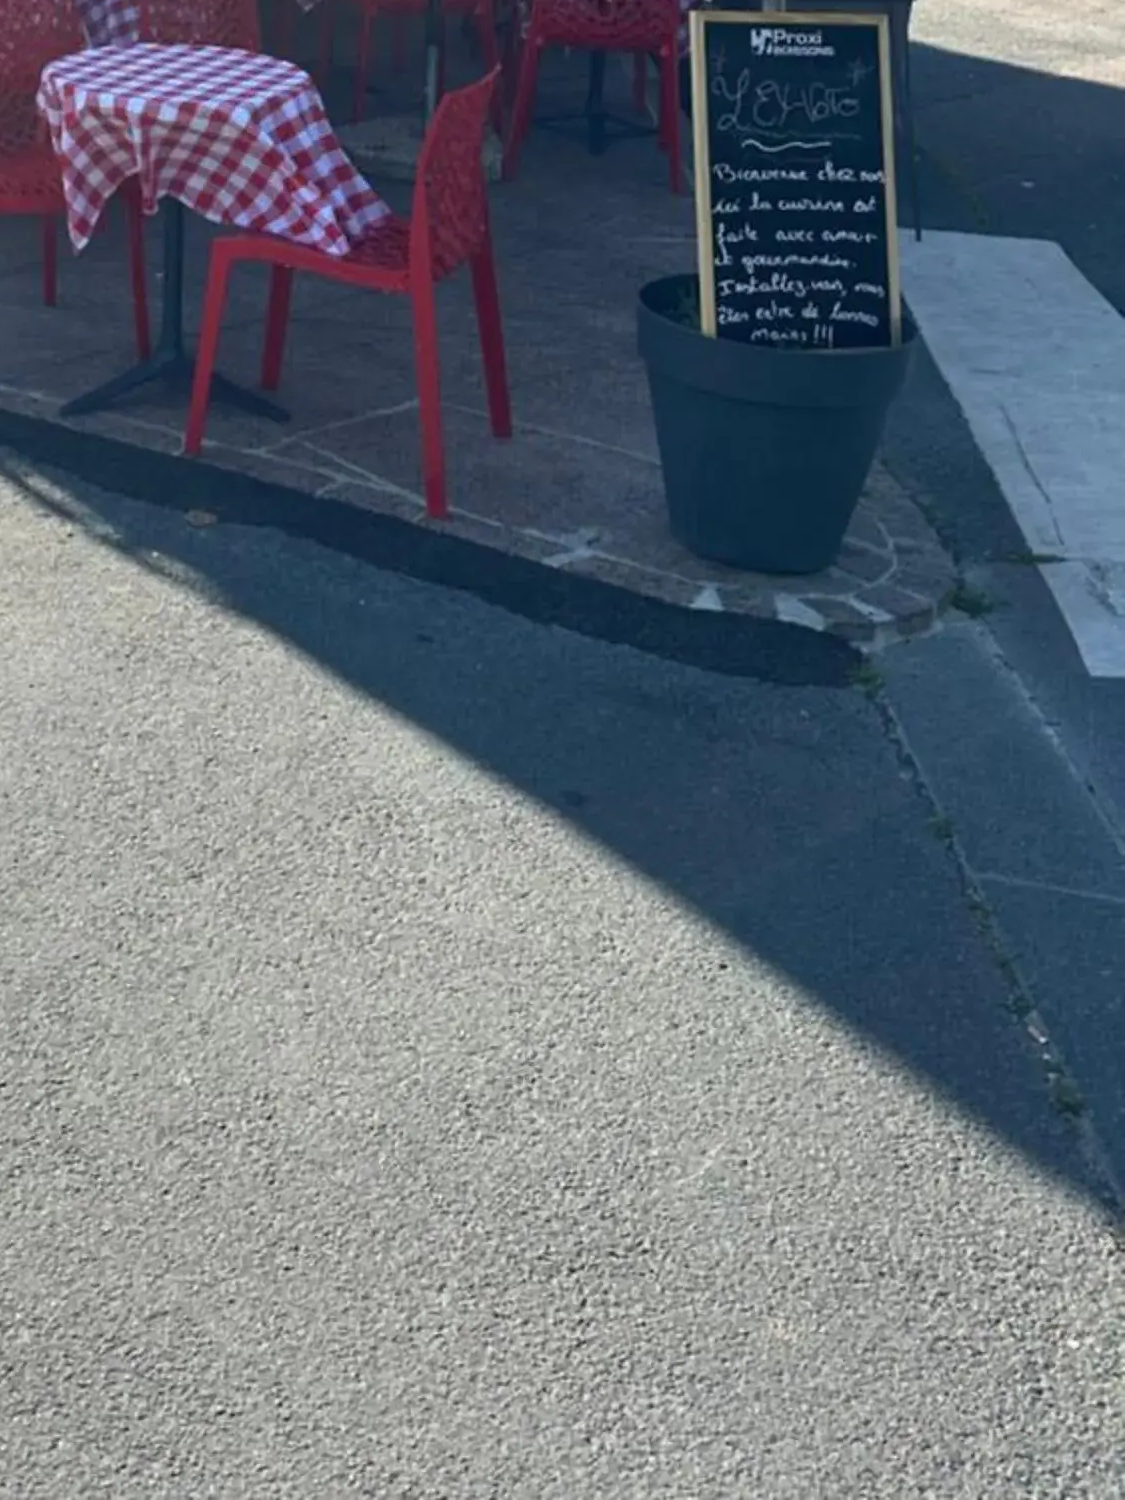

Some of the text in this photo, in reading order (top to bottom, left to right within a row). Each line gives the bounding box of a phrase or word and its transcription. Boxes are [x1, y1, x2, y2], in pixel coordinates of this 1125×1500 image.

[773, 29, 822, 45] Proxi
[713, 163, 809, 183] Bienvenue
[749, 191, 773, 211] la
[777, 198, 845, 213] cuisine
[716, 222, 878, 258] faite avec amour
[801, 301, 819, 319] de
